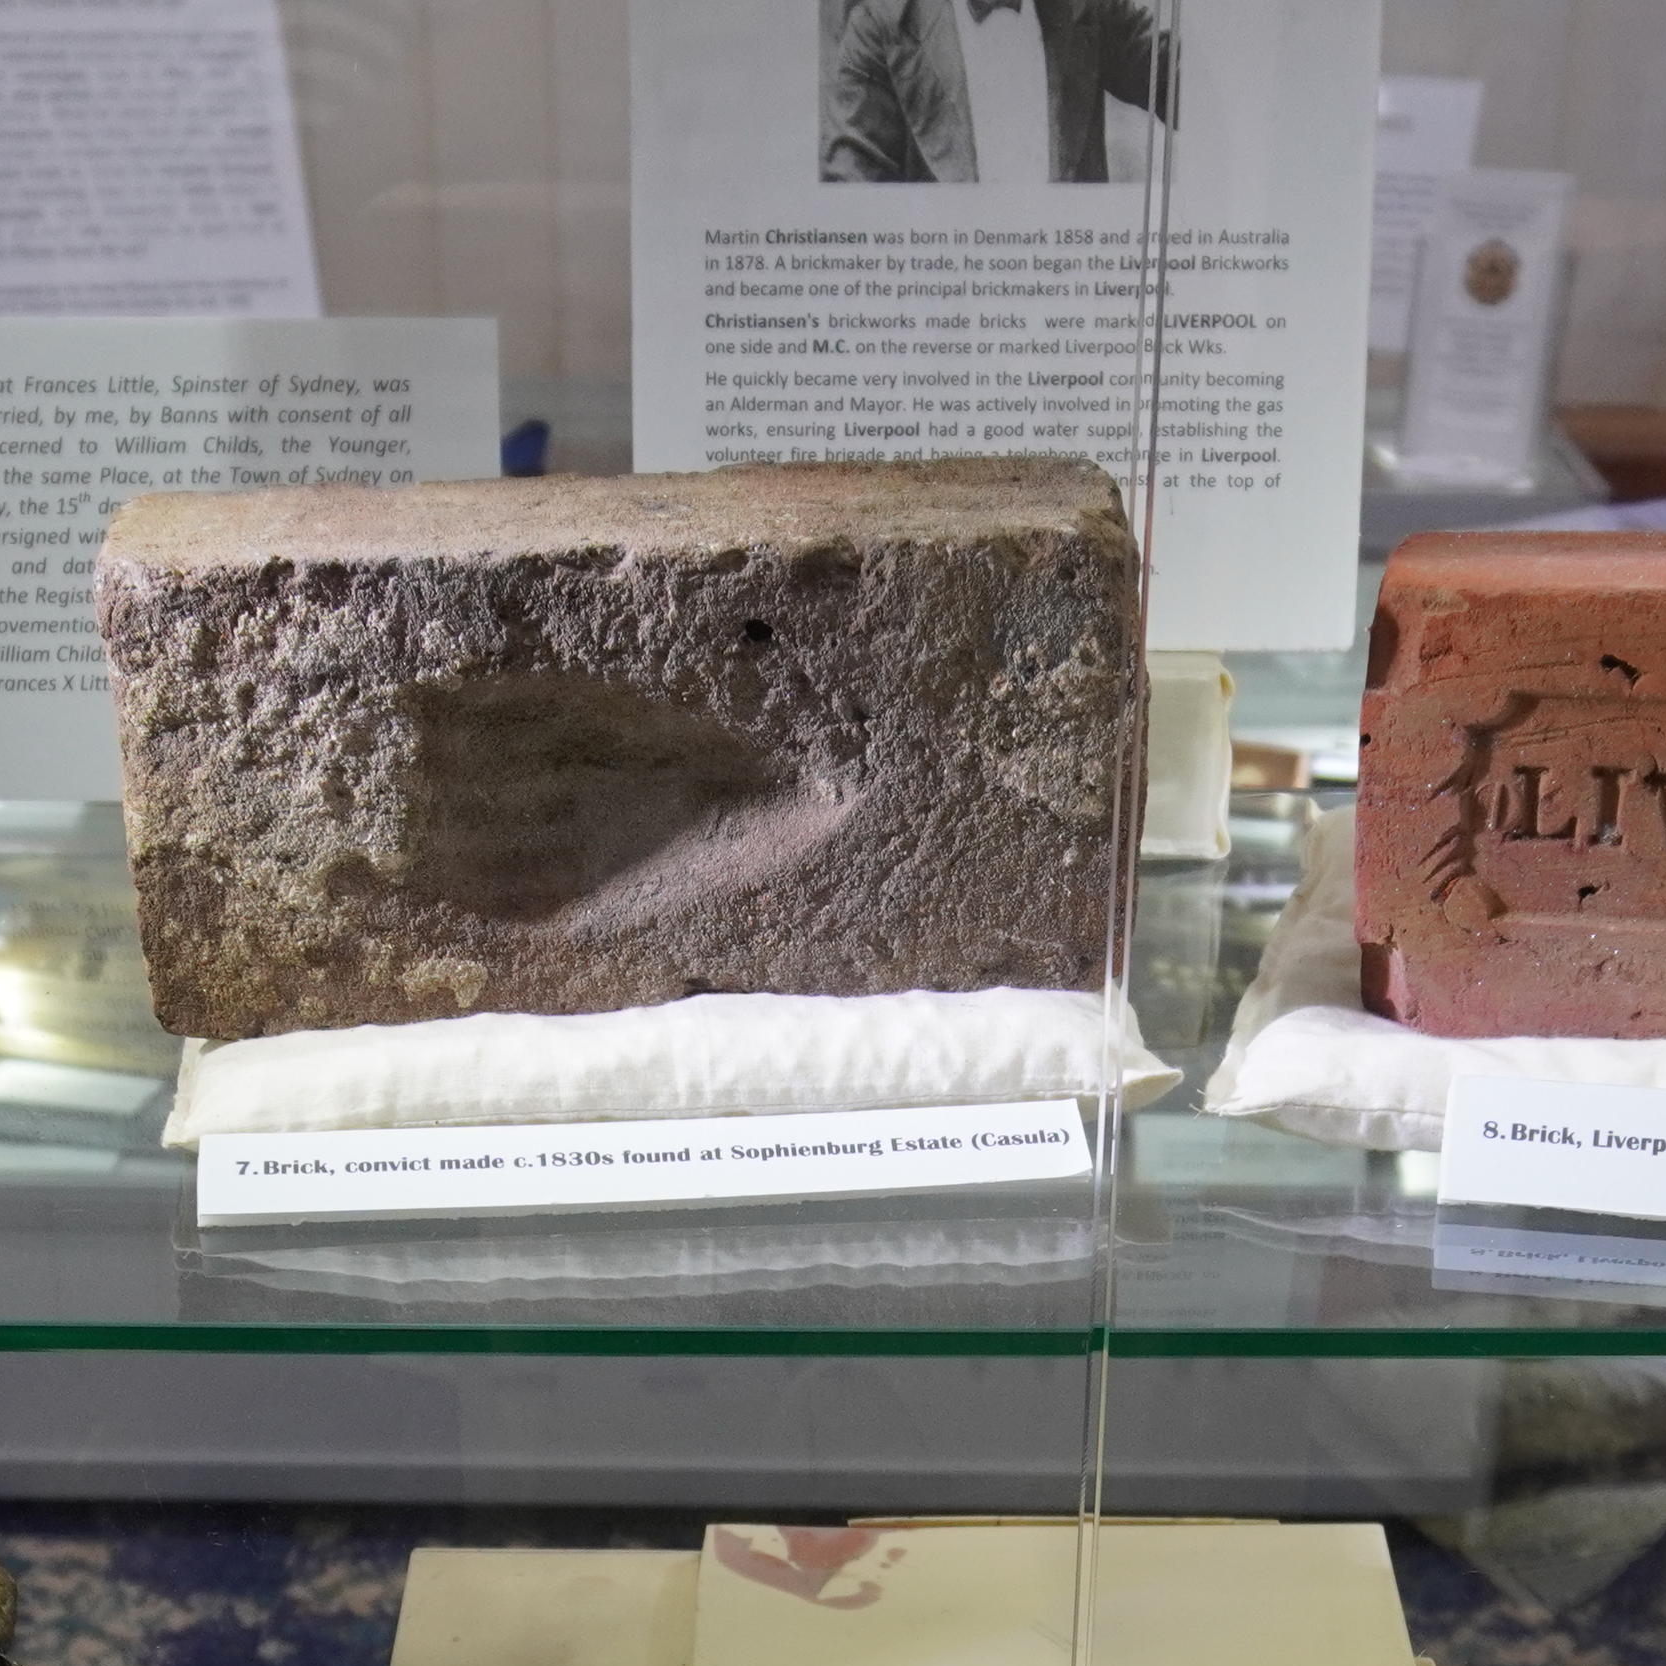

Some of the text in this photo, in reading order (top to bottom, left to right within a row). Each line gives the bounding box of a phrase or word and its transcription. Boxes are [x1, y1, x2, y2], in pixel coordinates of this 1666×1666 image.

[705, 229, 760, 246] Martin
[764, 228, 868, 245] Christiansen
[872, 232, 905, 245] was
[910, 228, 948, 245] born
[953, 229, 969, 245] in
[974, 229, 1048, 246] Denmark
[1055, 228, 1094, 245] 1858
[1099, 229, 1131, 245] and
[1198, 229, 1213, 245] in
[1218, 228, 1290, 246] Australia
[24, 375, 98, 394] Frances
[107, 374, 160, 397] Little,
[171, 375, 249, 398] Spinster
[258, 373, 281, 398] of
[288, 374, 361, 397] Sydney,
[372, 378, 410, 394] was
[344, 1156, 431, 1173] convict
[439, 1154, 505, 1170] made
[513, 1151, 615, 1168] c.1830s
[622, 1147, 691, 1164] found
[700, 1147, 722, 1161] at
[730, 1139, 884, 1162] Sophienburg
[890, 1136, 963, 1152] Estate
[971, 1128, 1070, 1150] (Casula)
